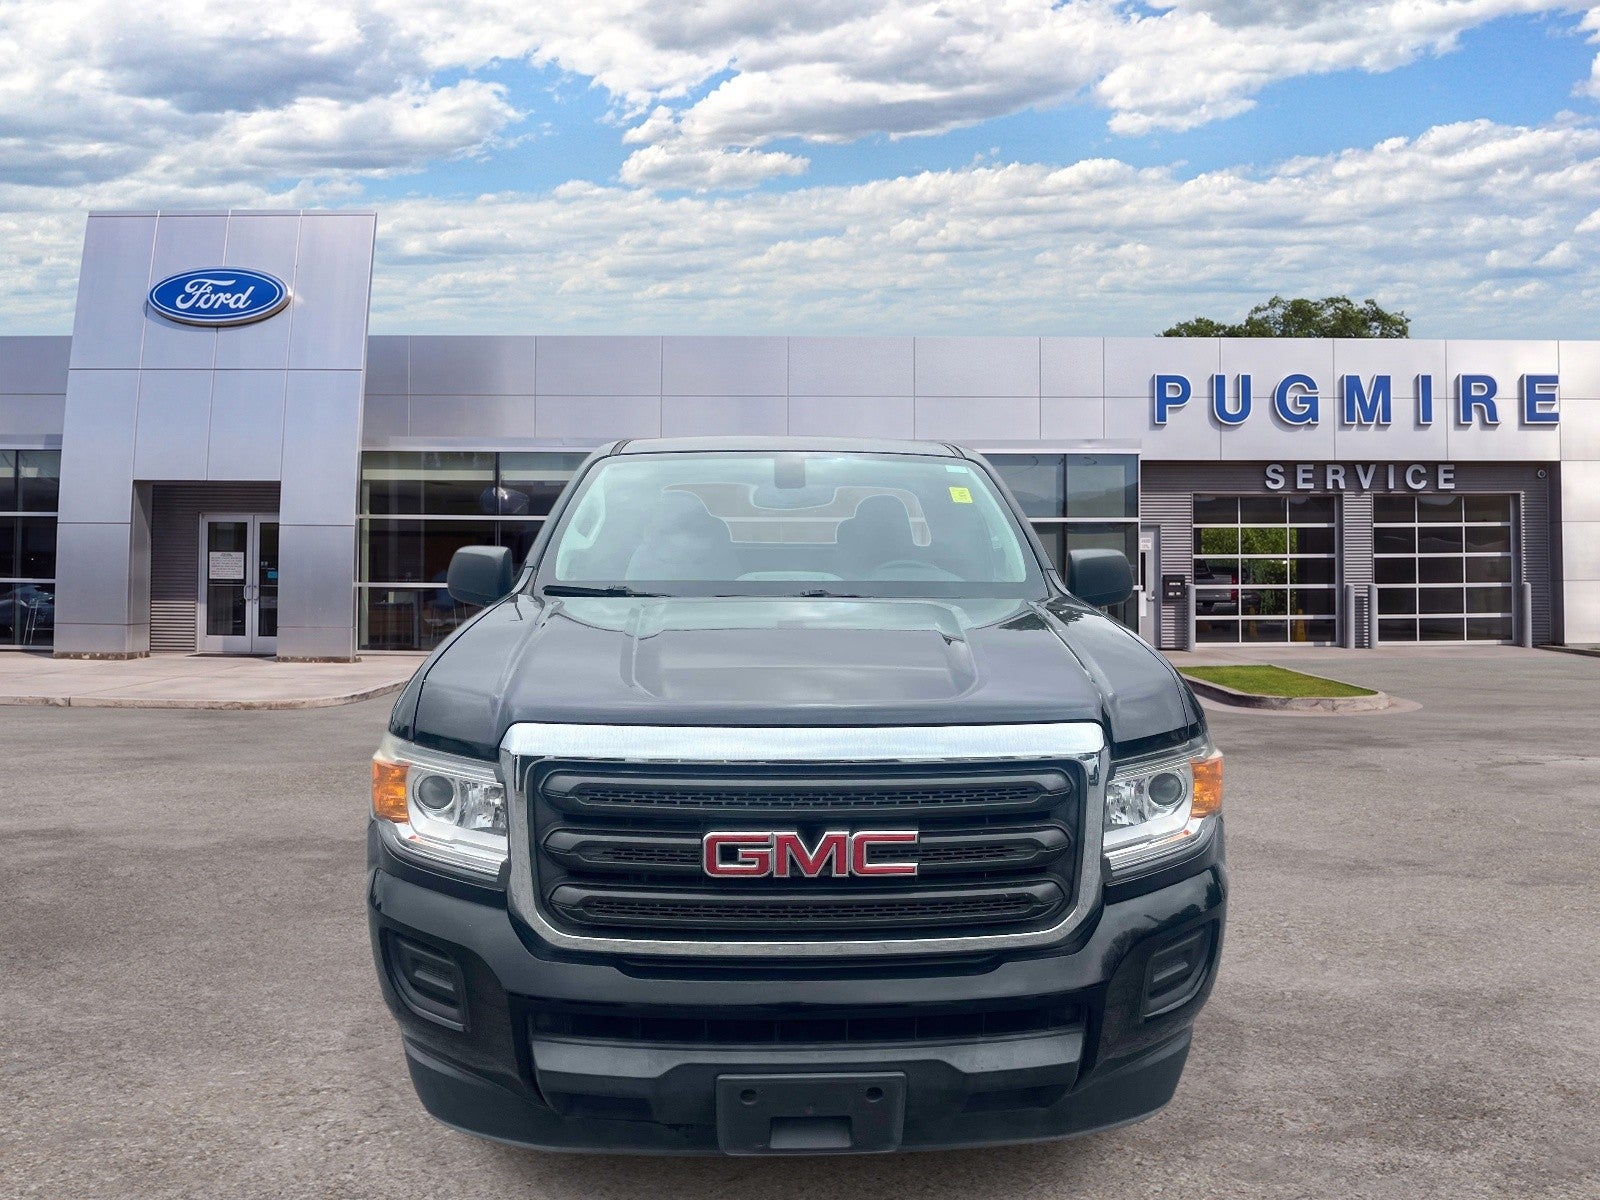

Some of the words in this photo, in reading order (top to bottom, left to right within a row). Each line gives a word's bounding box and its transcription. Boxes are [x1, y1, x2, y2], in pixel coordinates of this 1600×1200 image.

[175, 278, 255, 310] Ford
[1153, 373, 1560, 425] PUGMIRE
[1265, 464, 1456, 490] SERVICE
[703, 830, 919, 878] GMC
